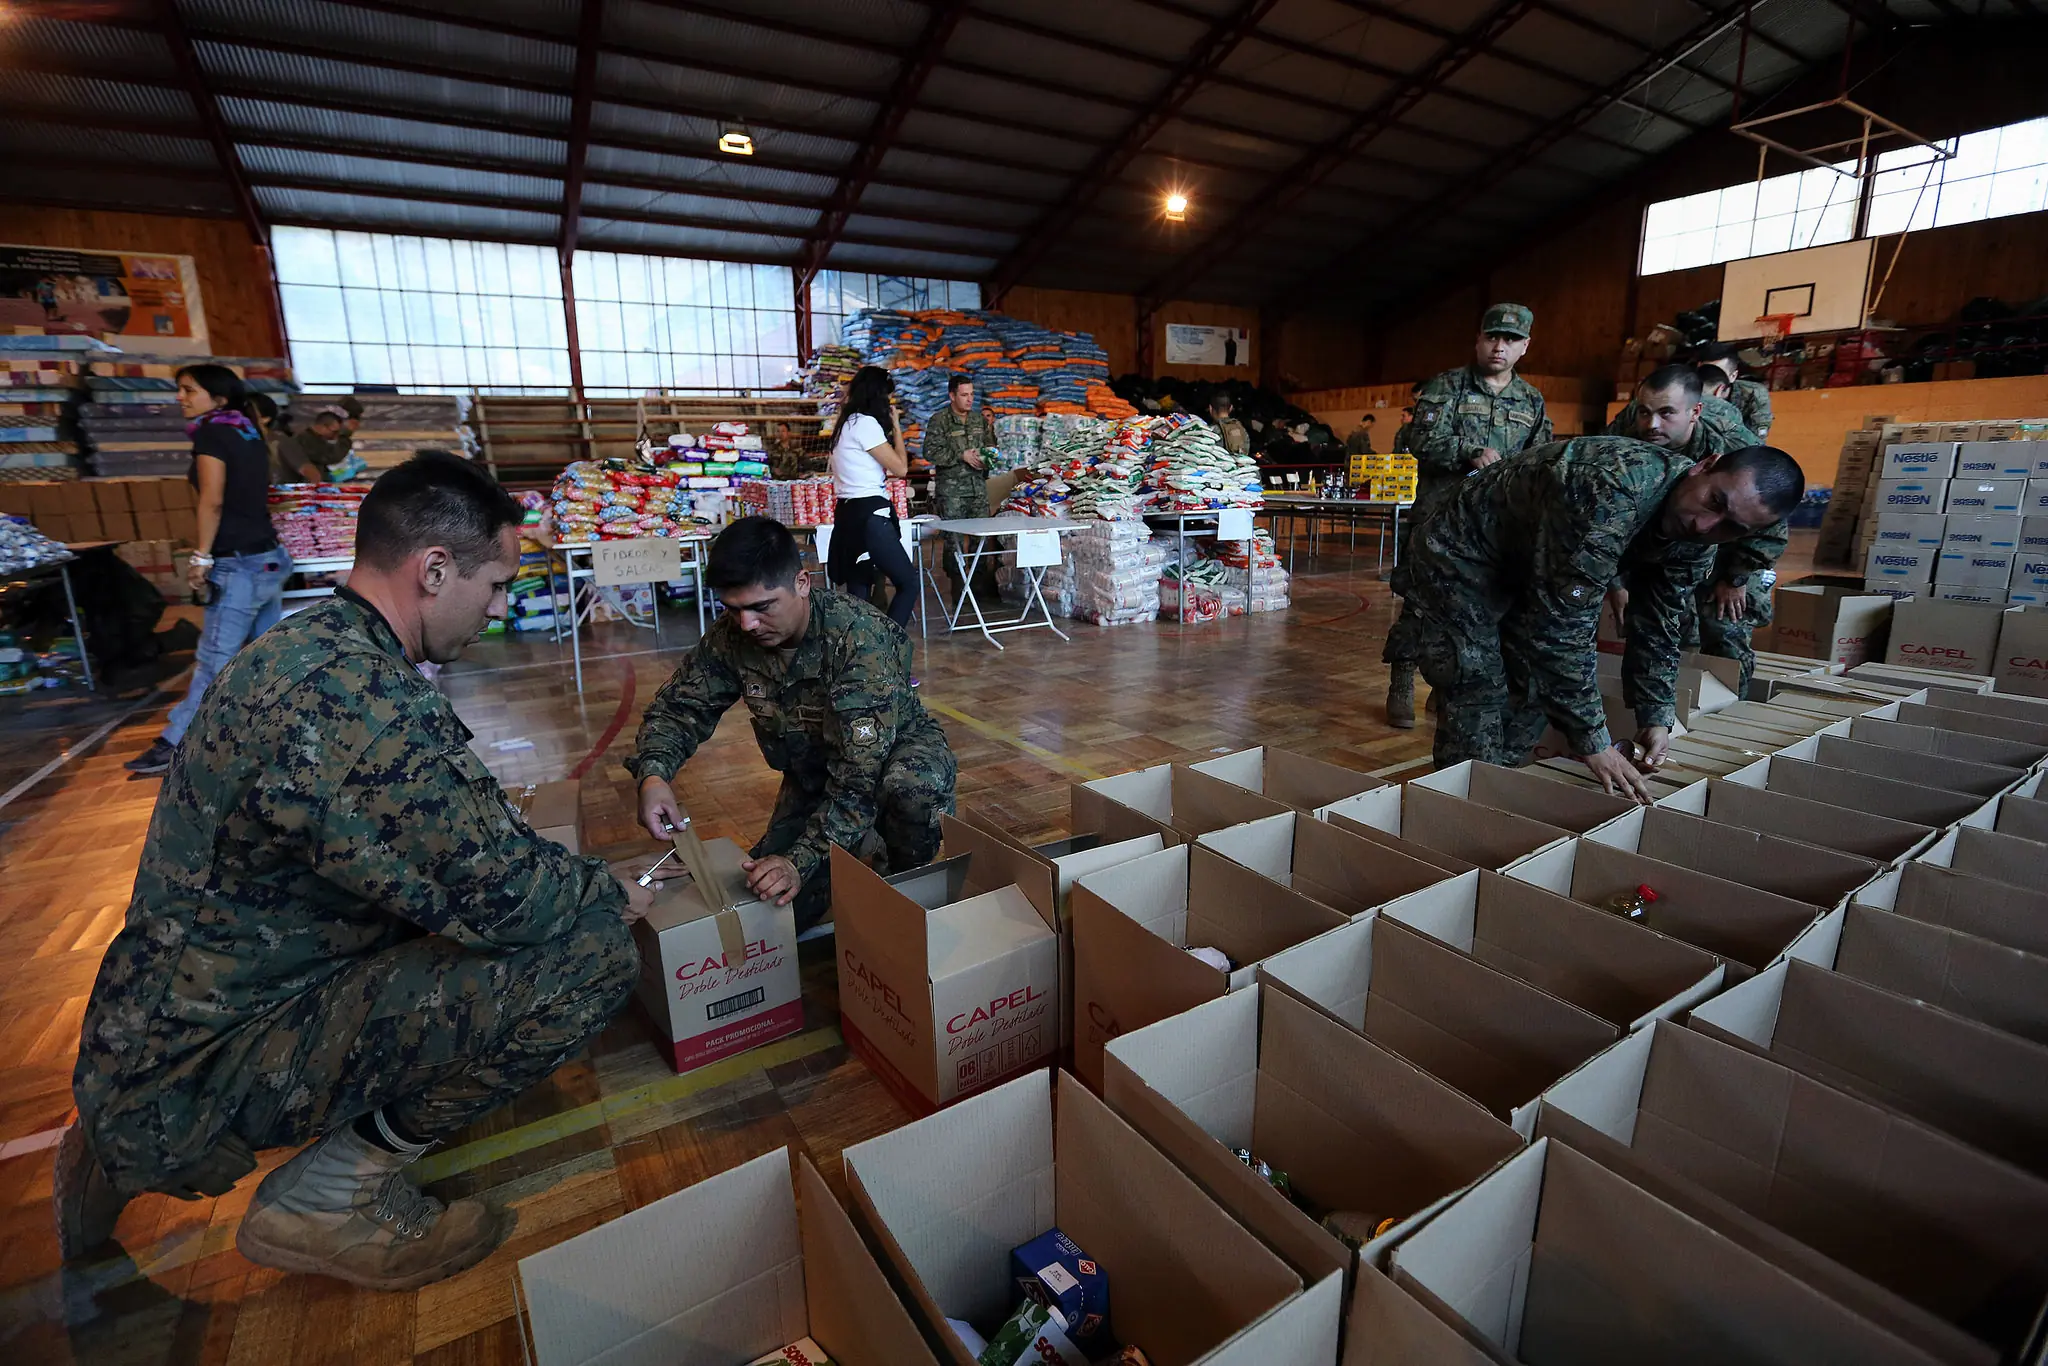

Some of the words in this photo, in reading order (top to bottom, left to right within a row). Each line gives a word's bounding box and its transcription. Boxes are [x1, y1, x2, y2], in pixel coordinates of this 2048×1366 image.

[1893, 451, 1939, 464] Nestlé
[1874, 554, 1918, 567] Nestlé
[1900, 643, 1975, 661] CAPEL
[679, 975, 721, 1000] Doble
[724, 955, 784, 985] Destilado
[844, 949, 912, 1024] CAPEL
[946, 985, 1042, 1034] CAPEL
[705, 1036, 725, 1049] PACK
[725, 1018, 776, 1043] PROMOCIONAL
[947, 1026, 986, 1056] Doble
[991, 1002, 1049, 1037] Destilado
